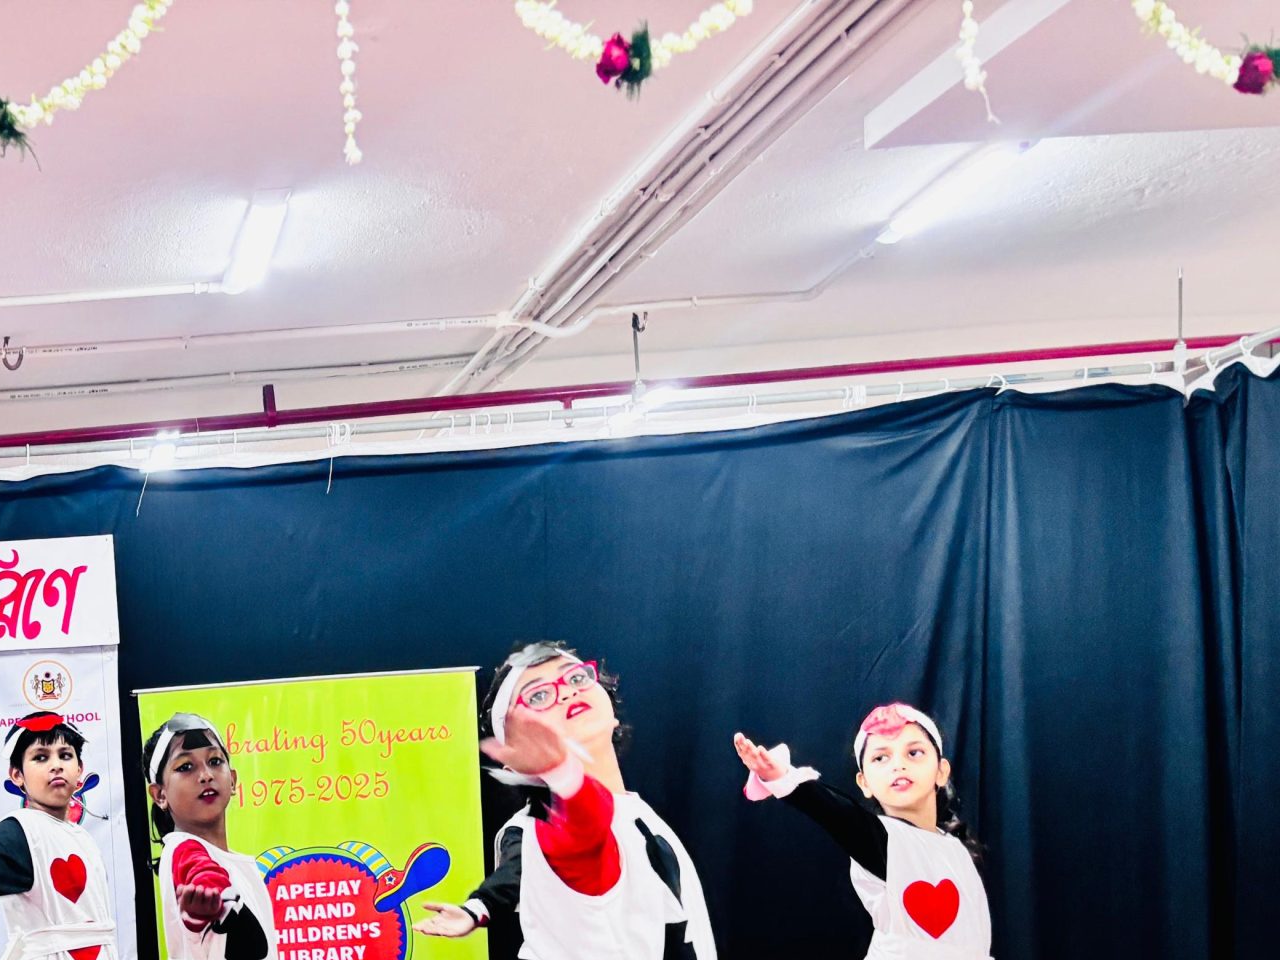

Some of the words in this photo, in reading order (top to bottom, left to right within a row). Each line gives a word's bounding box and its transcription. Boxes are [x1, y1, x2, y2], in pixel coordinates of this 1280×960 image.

[226, 722, 328, 763] brating
[340, 718, 451, 759] 50years
[237, 770, 390, 808] 1975-2025
[275, 879, 362, 901] APEEJAY
[284, 902, 356, 922] ANAND
[275, 921, 381, 944] HILDREN'S
